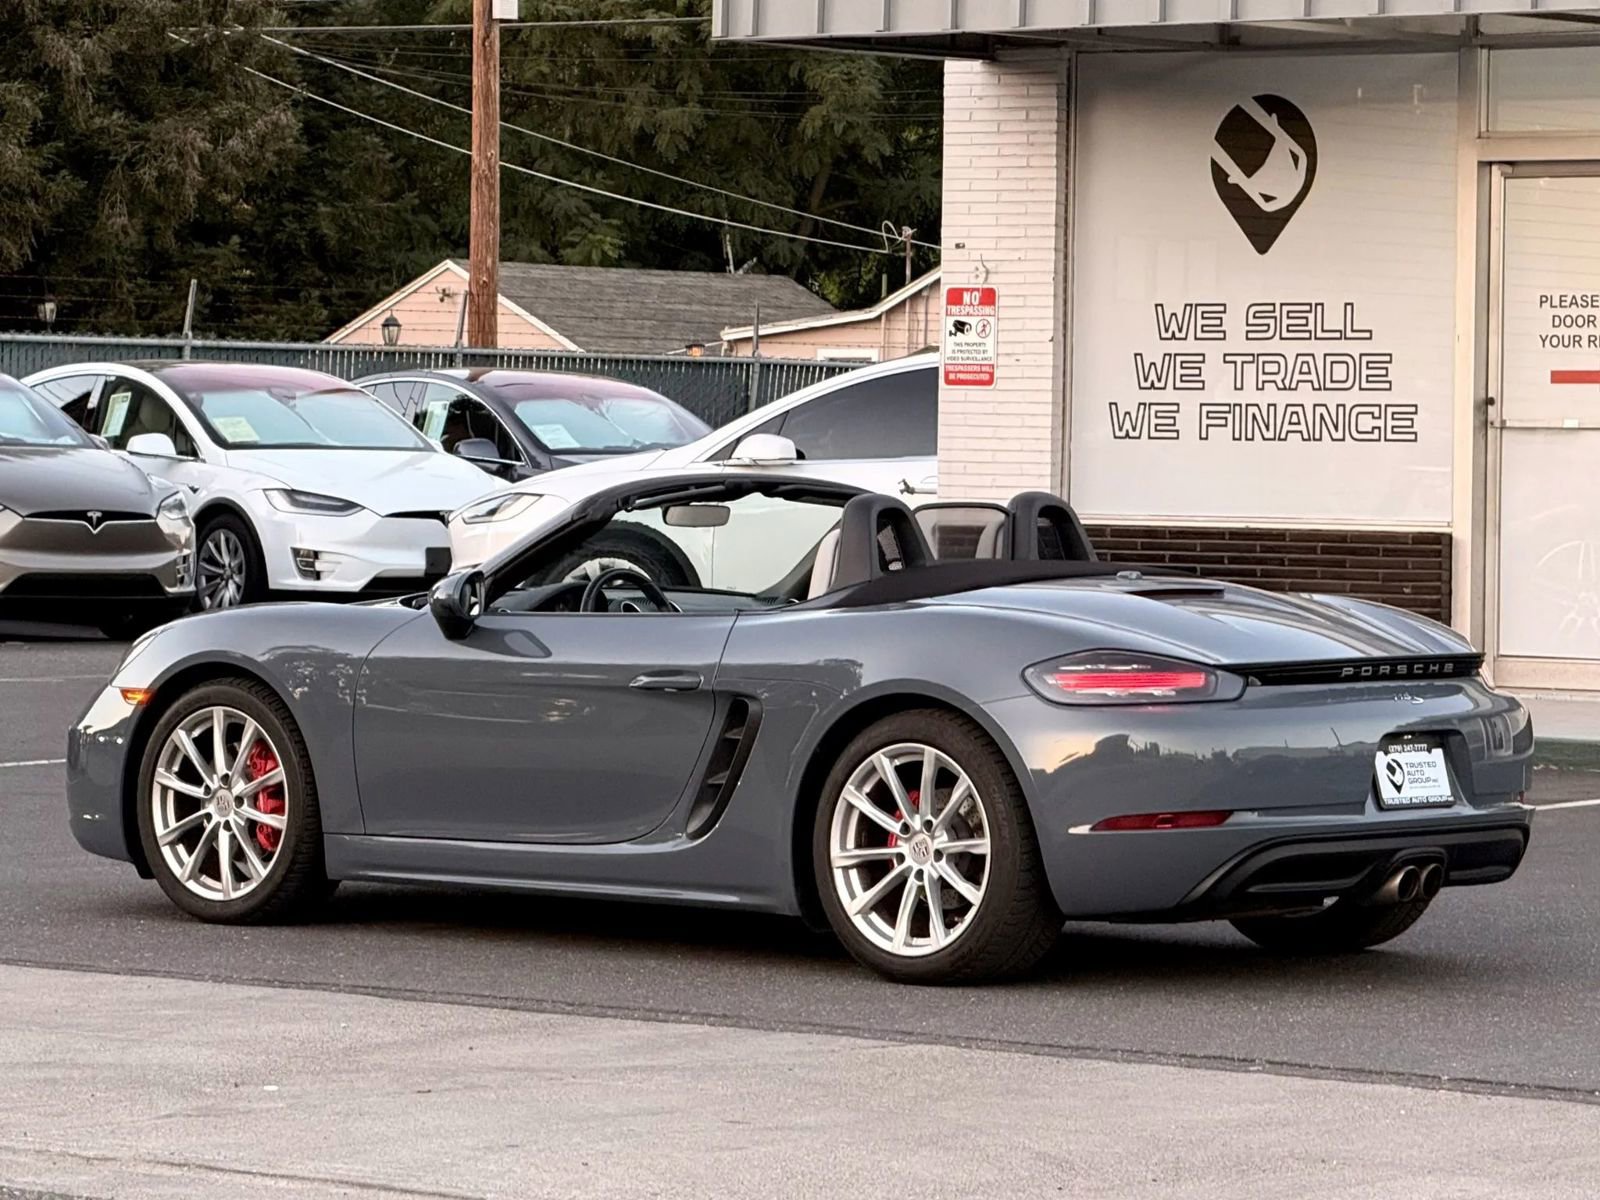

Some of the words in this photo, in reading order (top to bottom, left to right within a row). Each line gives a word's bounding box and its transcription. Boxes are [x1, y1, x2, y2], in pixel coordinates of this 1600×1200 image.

[963, 291, 980, 306] NO
[1539, 294, 1599, 309] PLEASE
[946, 305, 995, 316] TRESPASSING
[1154, 303, 1226, 341] WE
[1245, 302, 1373, 341] SELL
[1552, 314, 1597, 329] DOOR
[1539, 334, 1583, 349] YOUR
[1133, 353, 1206, 391] WE
[1223, 353, 1393, 391] TRADE
[1109, 402, 1180, 440] WE
[1199, 403, 1418, 442] FINANCE
[1340, 663, 1454, 677] PORSCHE
